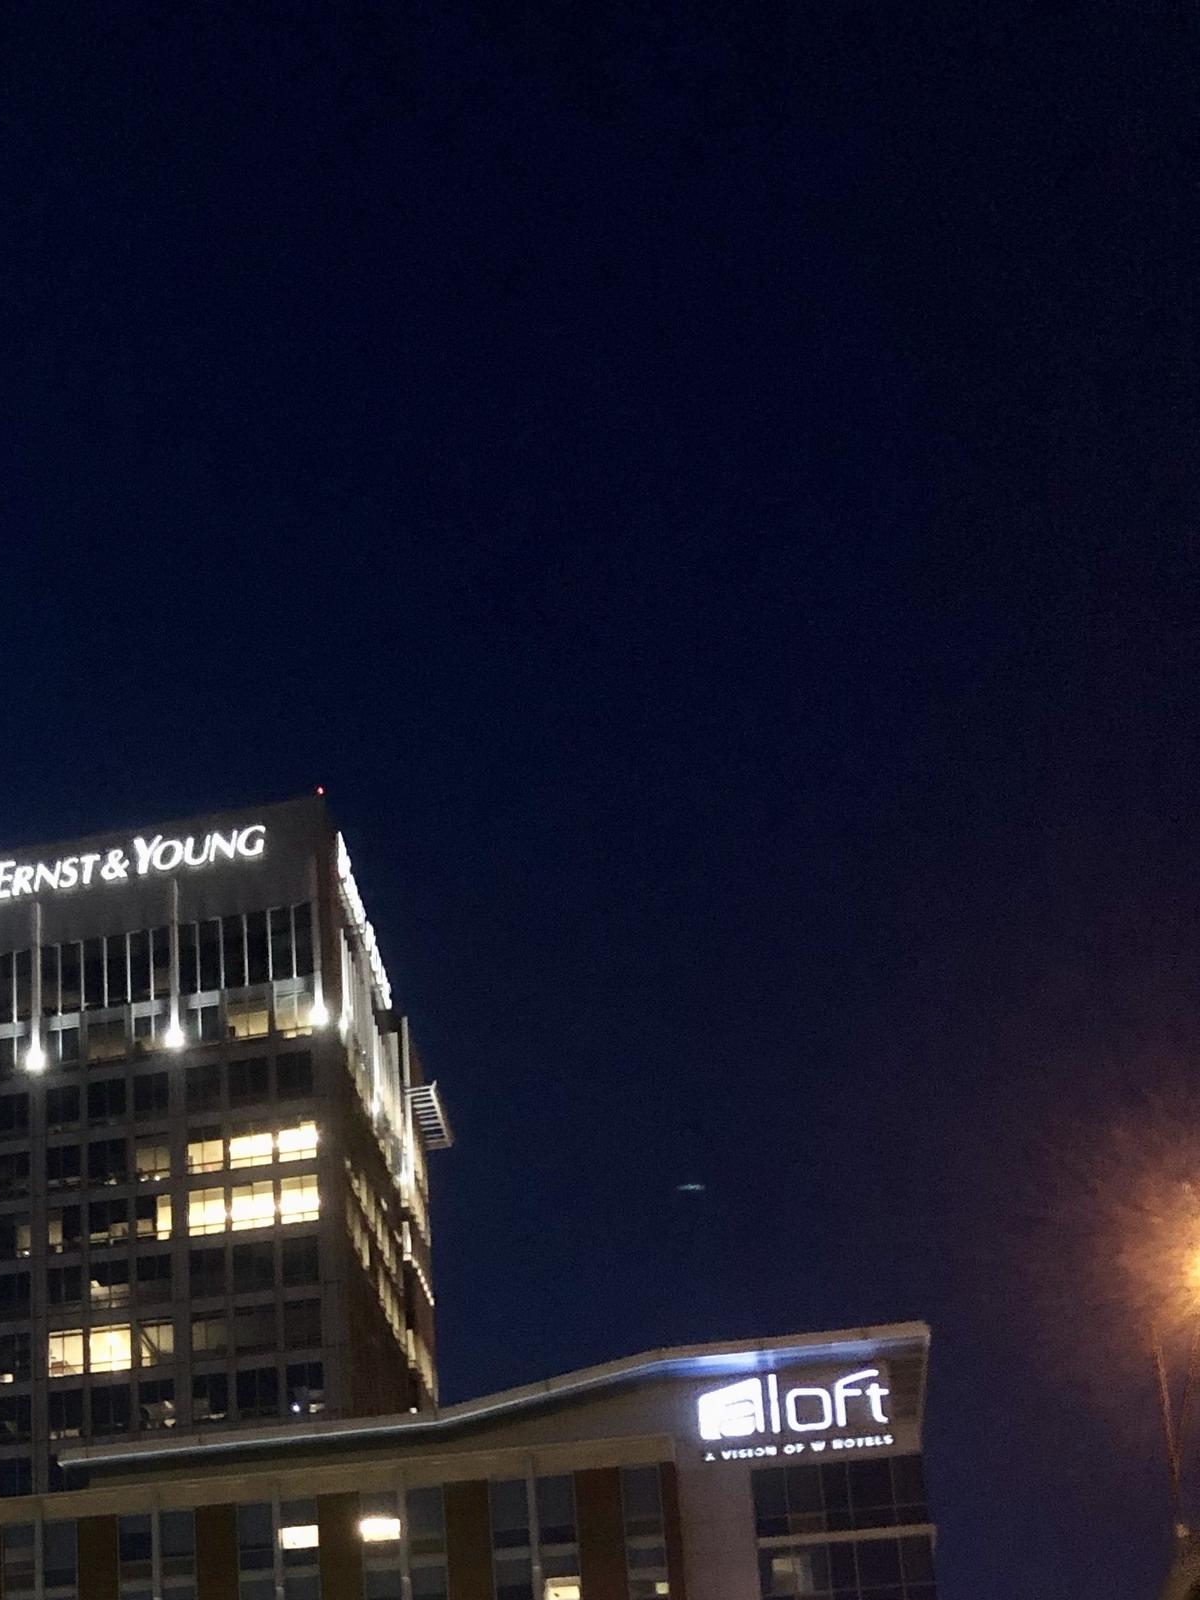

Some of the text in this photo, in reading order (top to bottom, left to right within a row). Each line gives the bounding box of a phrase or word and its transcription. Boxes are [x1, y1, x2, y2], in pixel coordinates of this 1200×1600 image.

[133, 825, 266, 874] YOUNG
[698, 1368, 890, 1440] aloft
[722, 1446, 777, 1460] VISION
[783, 1443, 805, 1455] OF
[810, 1440, 826, 1452] W
[832, 1434, 894, 1450] HOTELS
